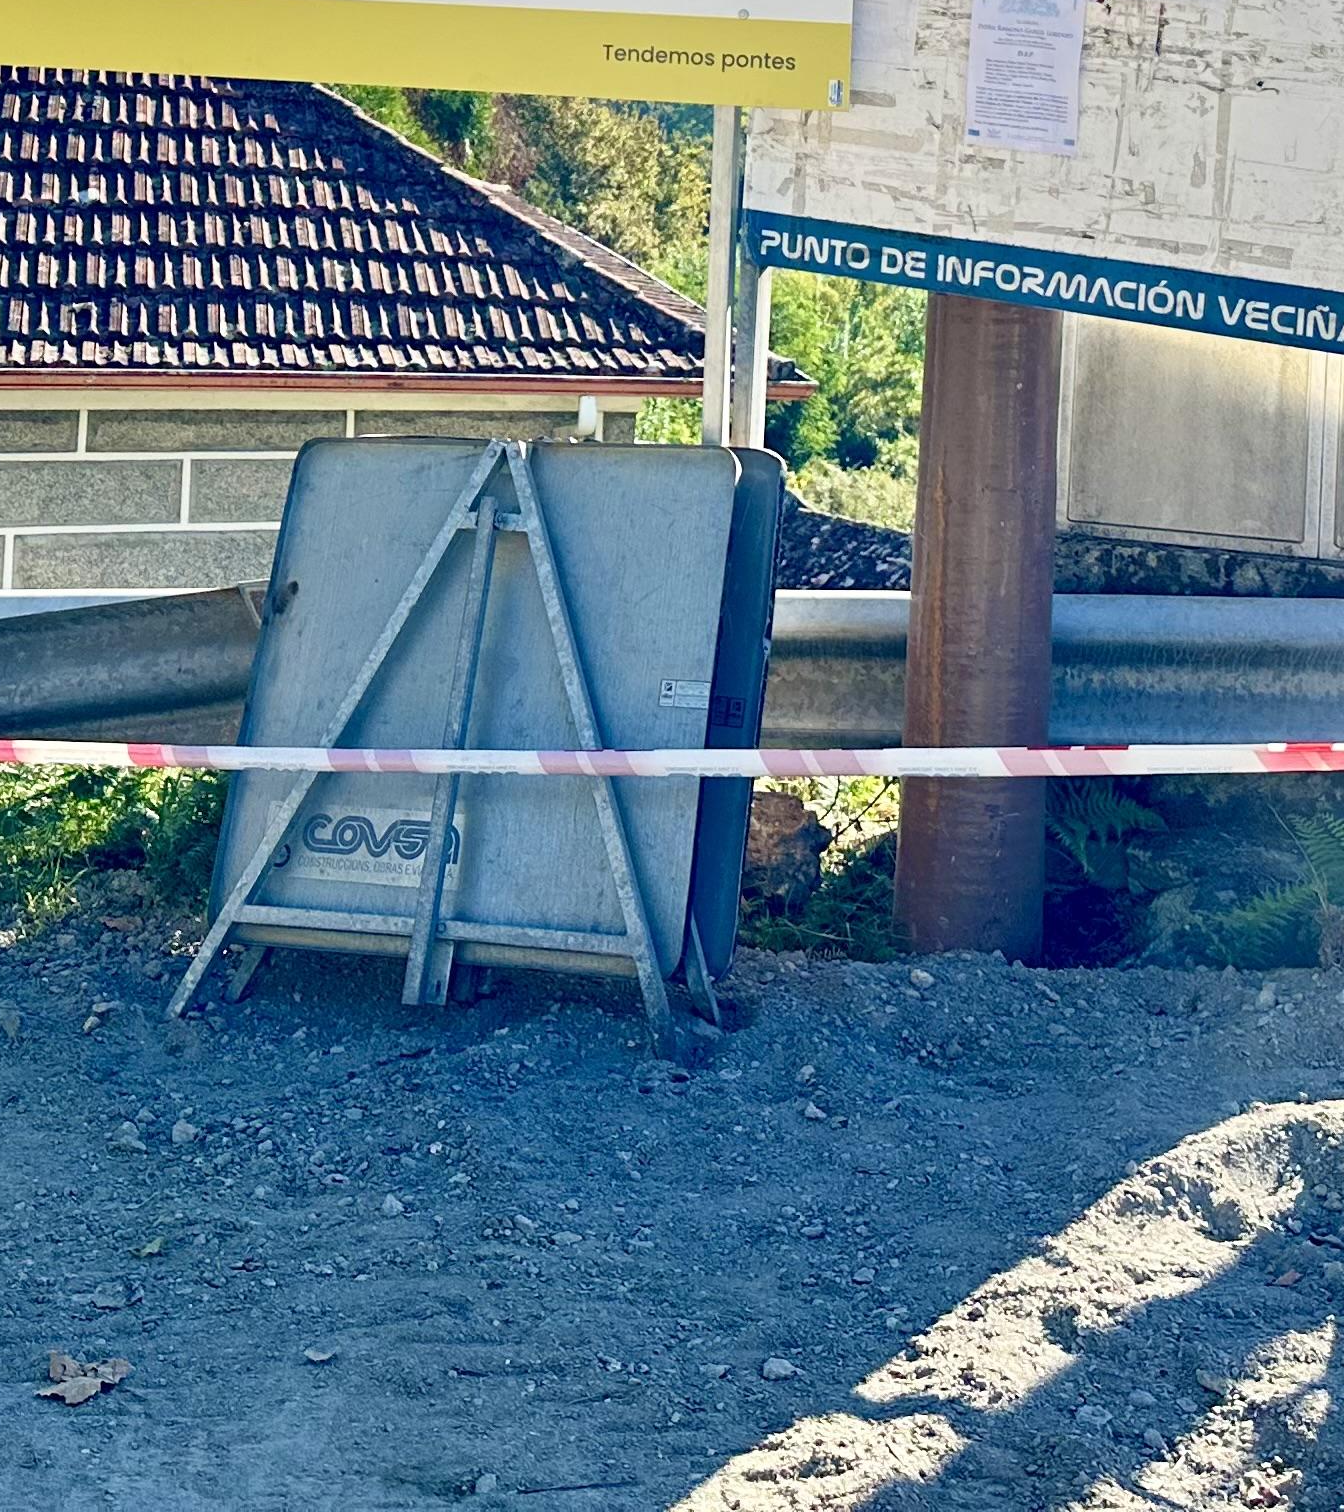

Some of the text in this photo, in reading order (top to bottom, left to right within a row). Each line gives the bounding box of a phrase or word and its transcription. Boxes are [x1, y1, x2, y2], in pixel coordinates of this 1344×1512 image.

[602, 44, 796, 73] Tendemos pontes
[759, 229, 870, 271] PUNTO
[880, 246, 927, 279] DE
[936, 252, 1205, 322] INFORMACIÓN
